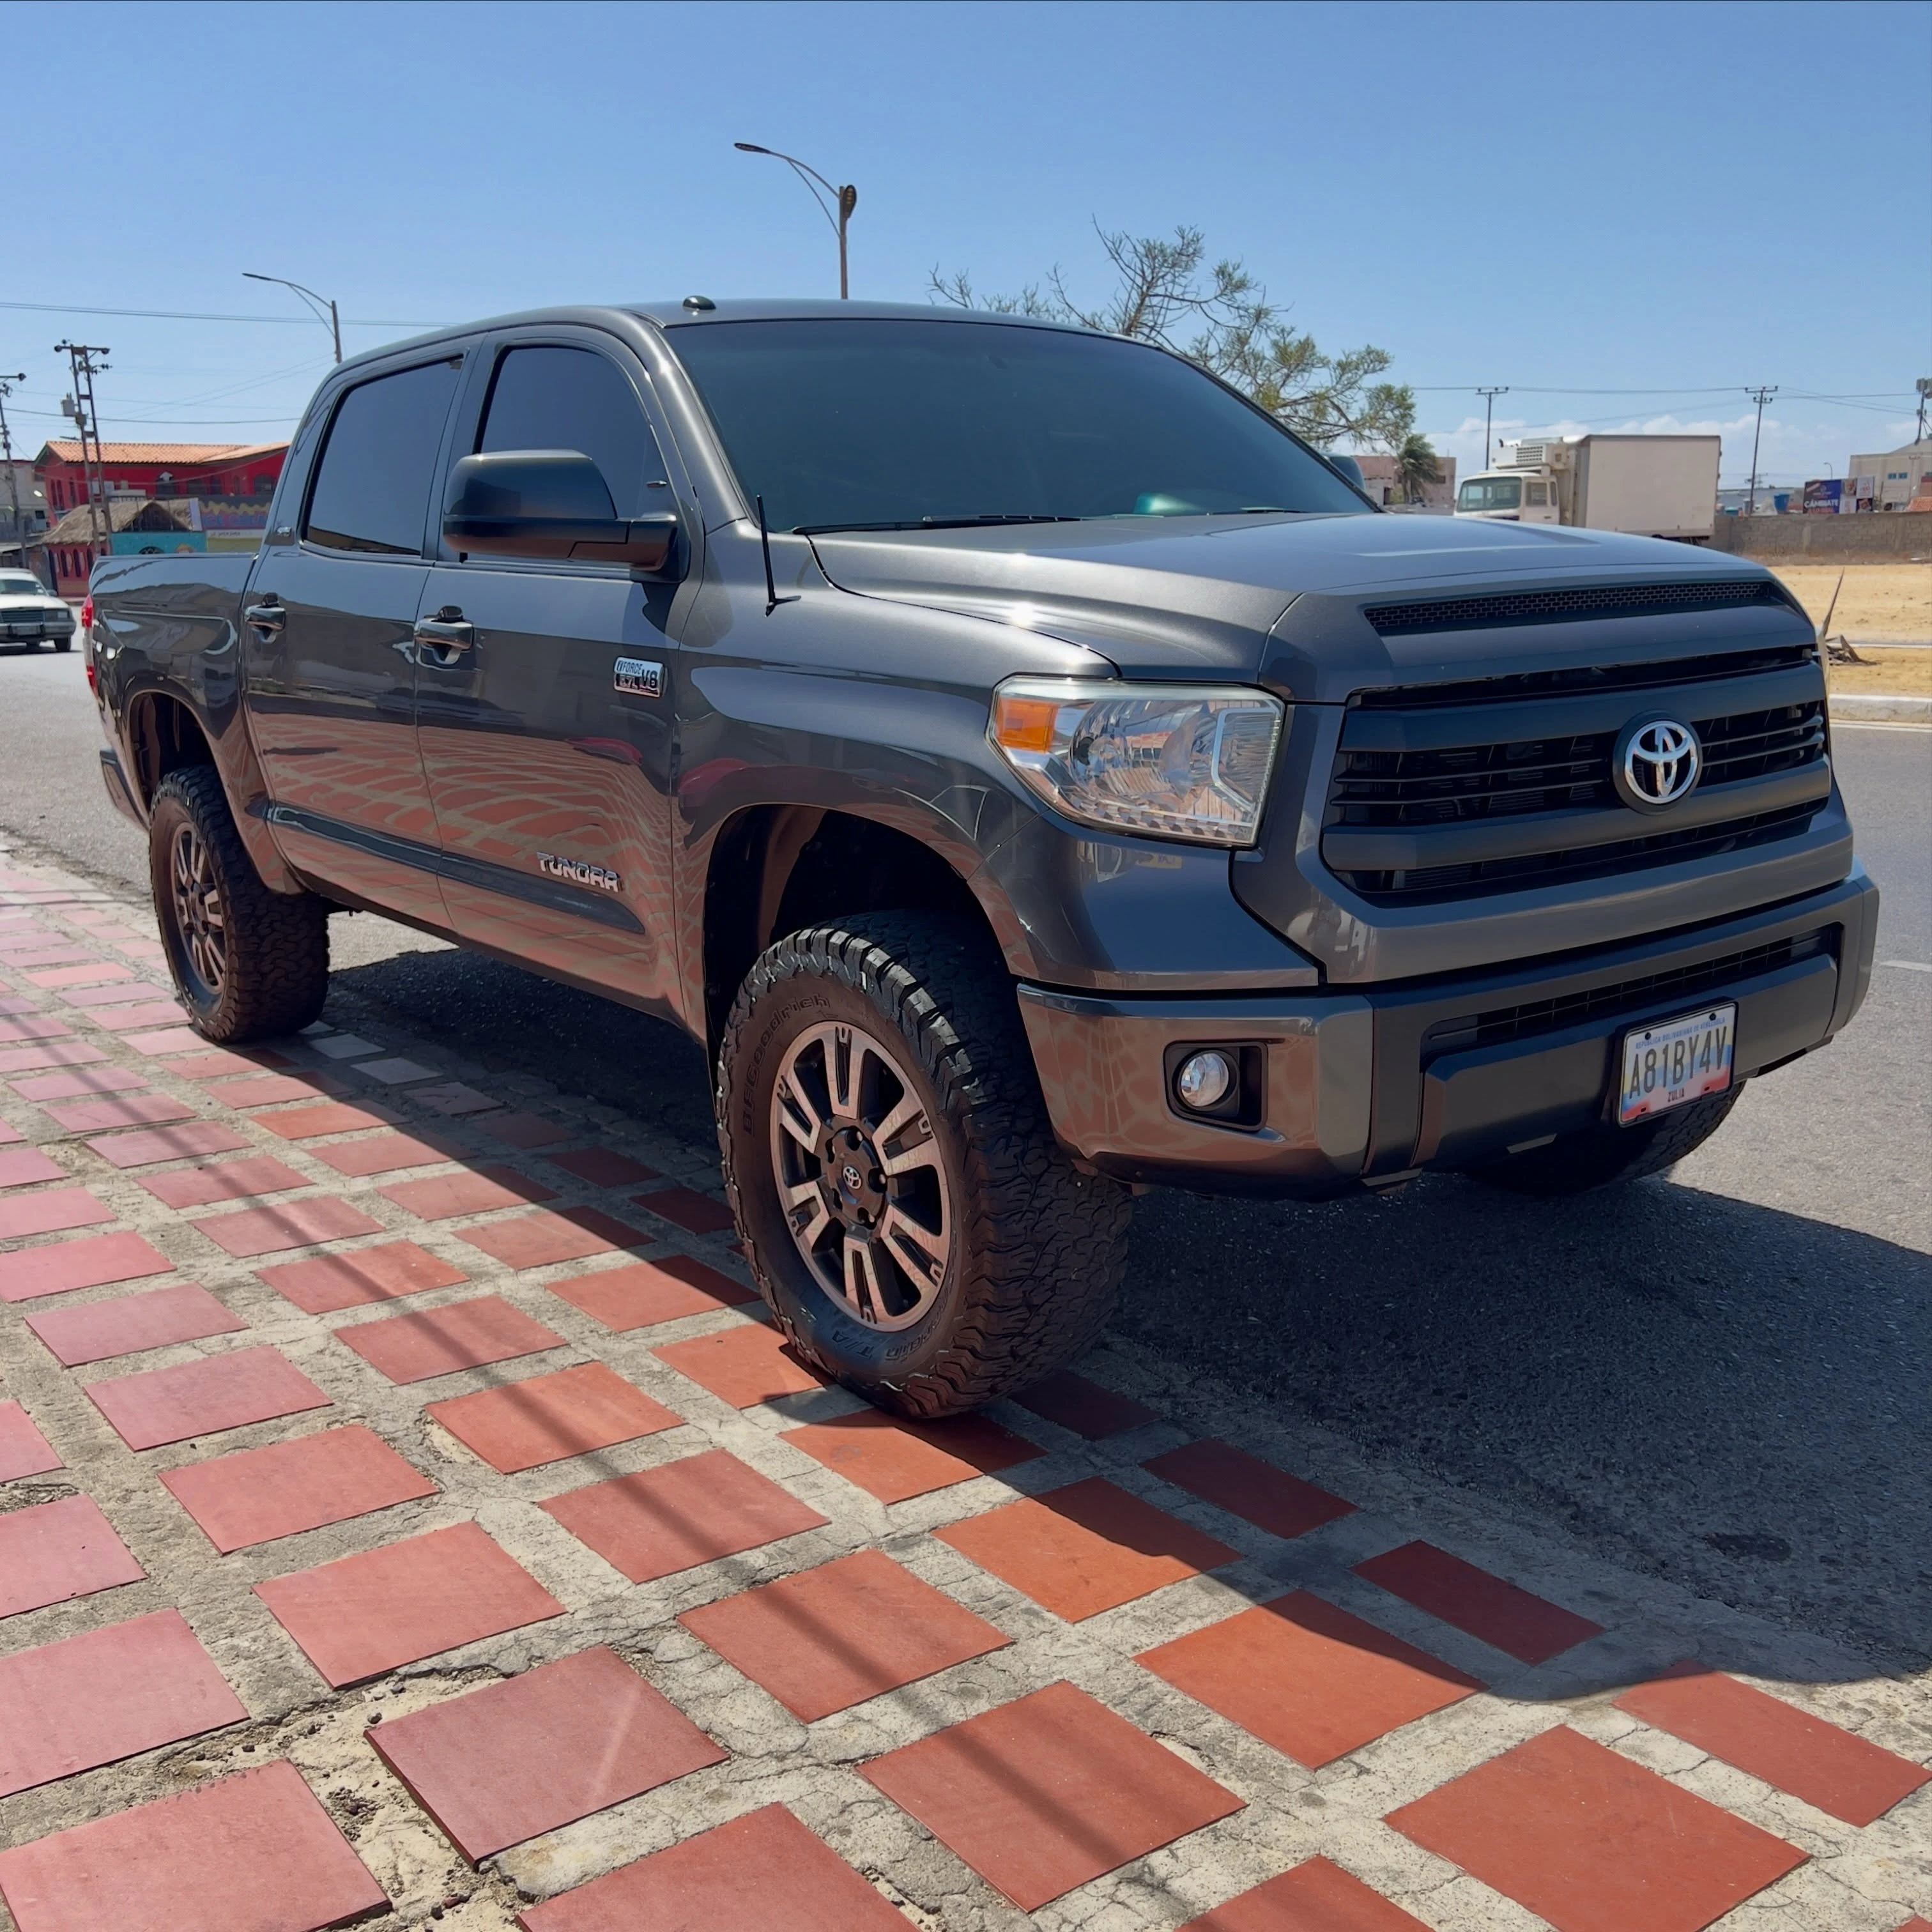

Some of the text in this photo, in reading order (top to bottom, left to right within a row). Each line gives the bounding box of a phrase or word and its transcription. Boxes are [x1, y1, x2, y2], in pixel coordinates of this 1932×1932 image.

[641, 669, 658, 689] V8
[537, 852, 619, 893] TUNDRA
[1630, 1025, 1727, 1100] A81BY4V
[1667, 1087, 1685, 1103] ZULIA
